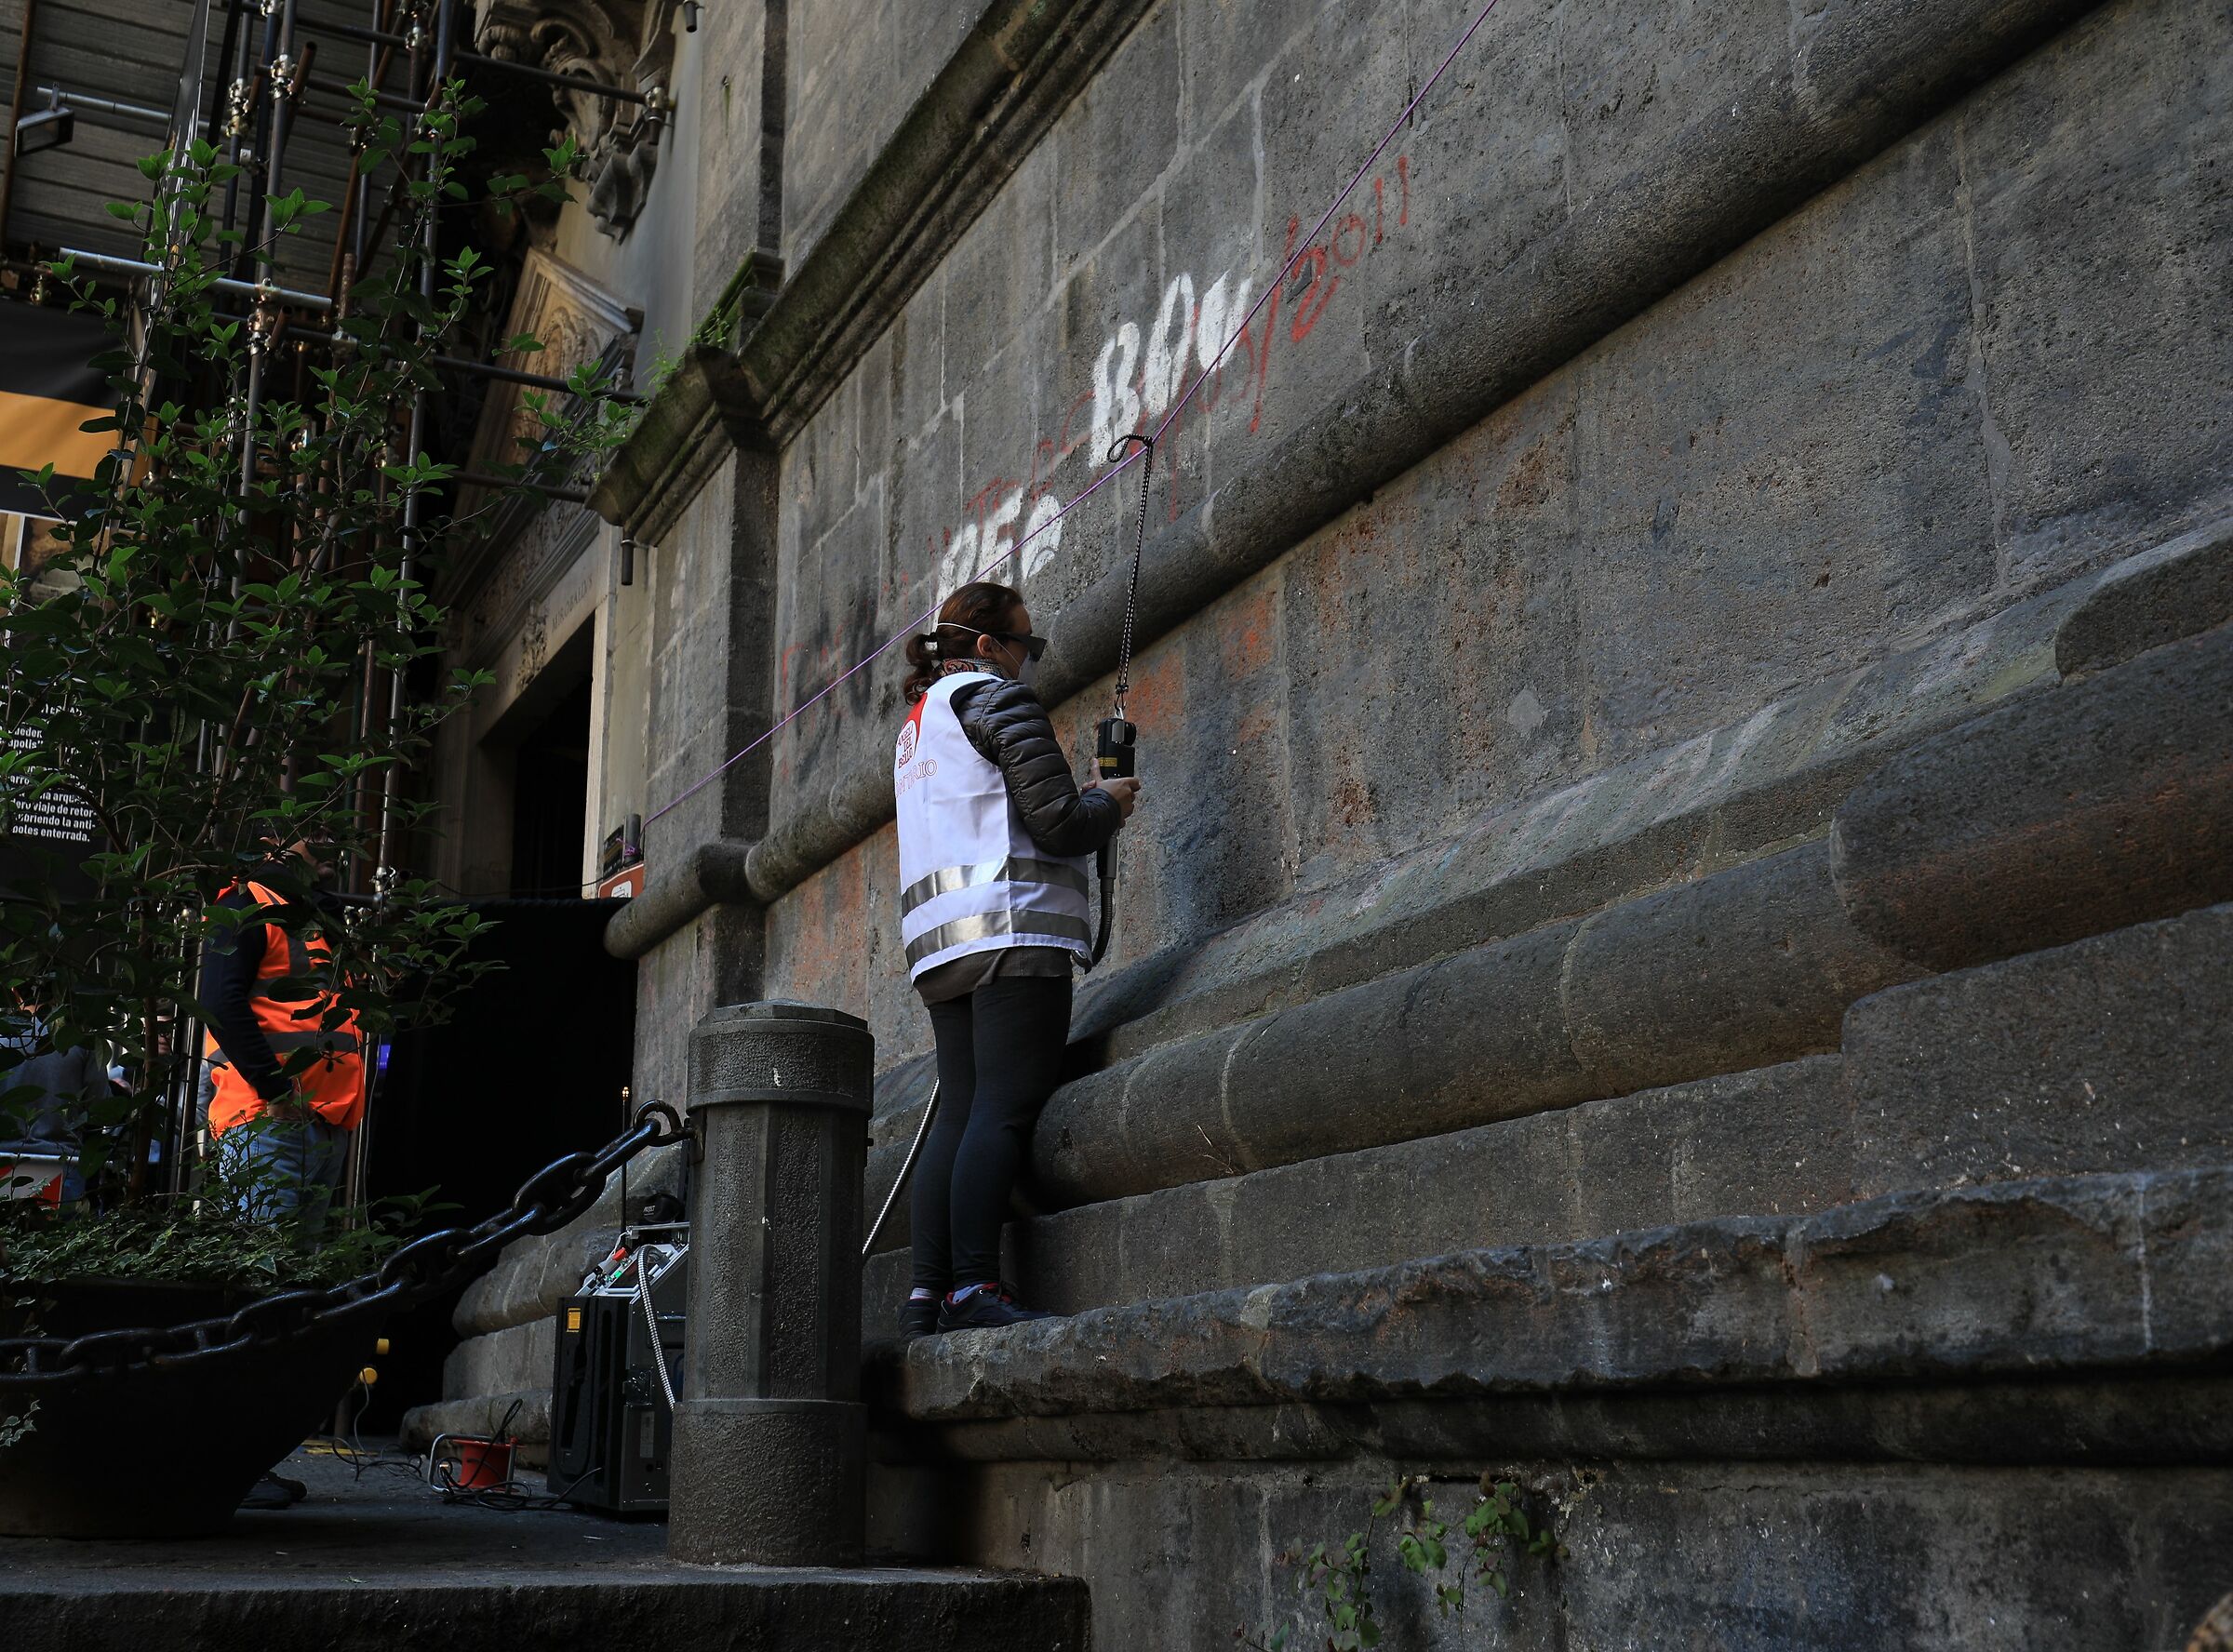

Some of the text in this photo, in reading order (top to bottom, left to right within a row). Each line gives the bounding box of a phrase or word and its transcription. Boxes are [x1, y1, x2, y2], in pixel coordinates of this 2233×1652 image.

[57, 804, 69, 815] de
[70, 806, 97, 818] retor-
[62, 817, 72, 827] la
[74, 819, 96, 830] anti-
[40, 828, 90, 843] enterrada.
